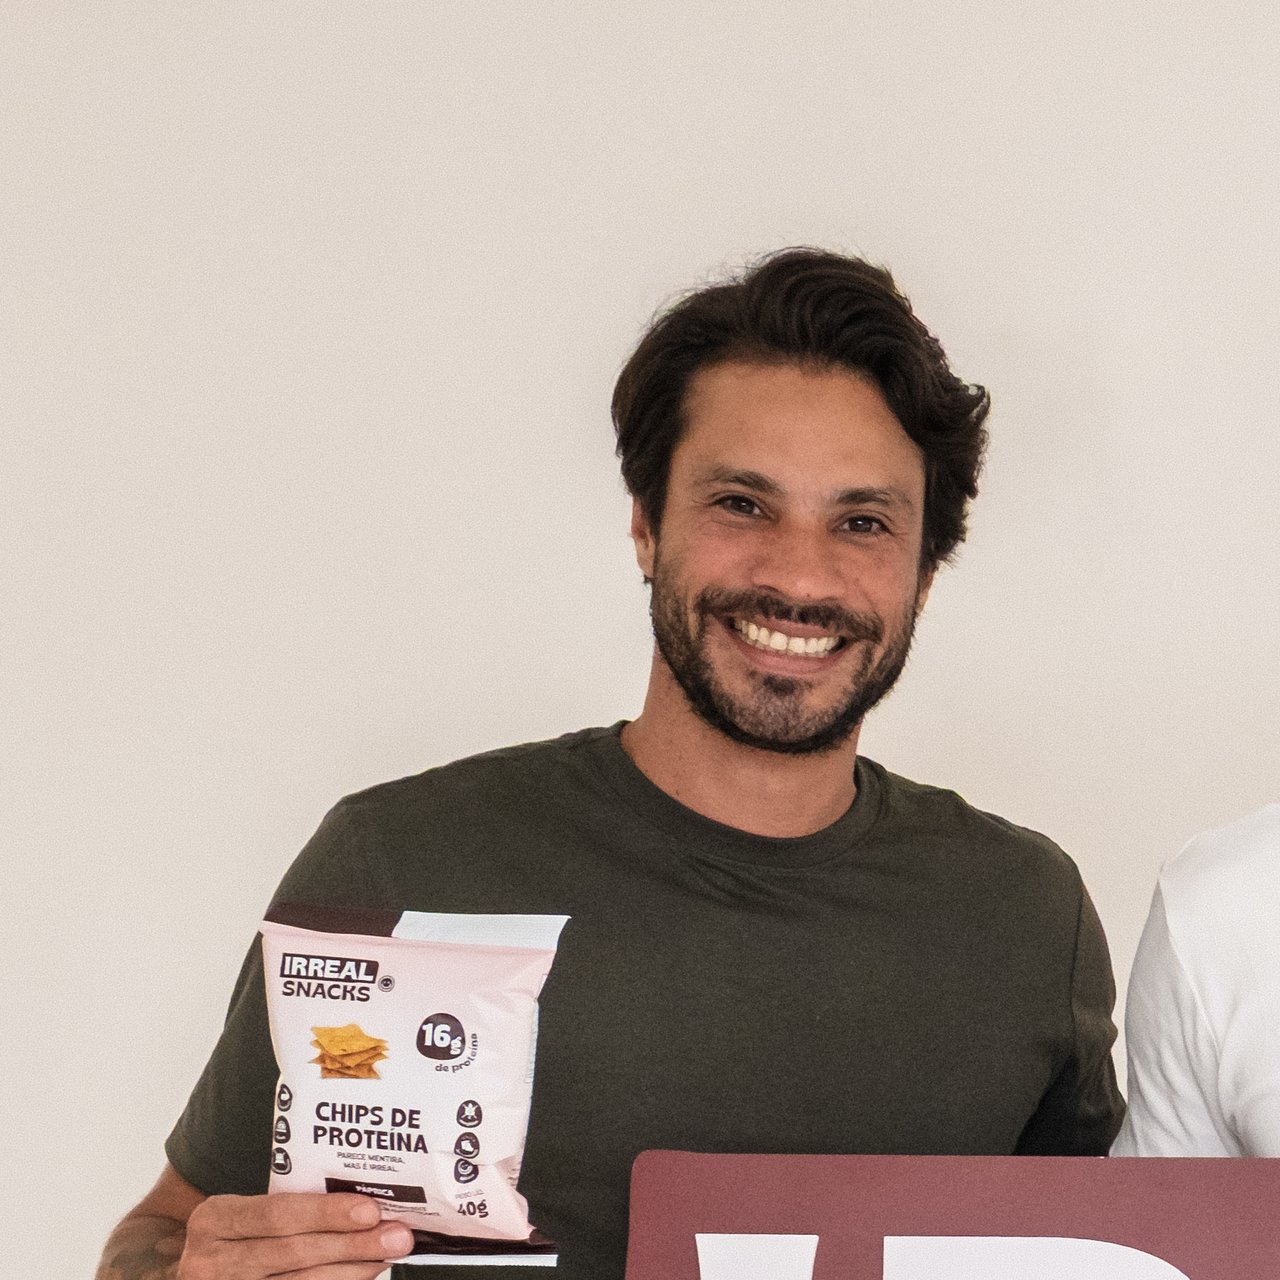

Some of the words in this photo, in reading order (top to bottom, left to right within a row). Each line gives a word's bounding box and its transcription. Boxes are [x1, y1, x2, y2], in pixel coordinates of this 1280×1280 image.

[283, 956, 375, 981] IRREAL
[282, 980, 371, 1003] SNACKS
[421, 1022, 463, 1056] 16g
[434, 1063, 450, 1073] de
[314, 1101, 385, 1127] CHIPS
[390, 1107, 422, 1130] DE
[313, 1125, 429, 1154] PROTEÍNA
[456, 1198, 490, 1219] 40g
